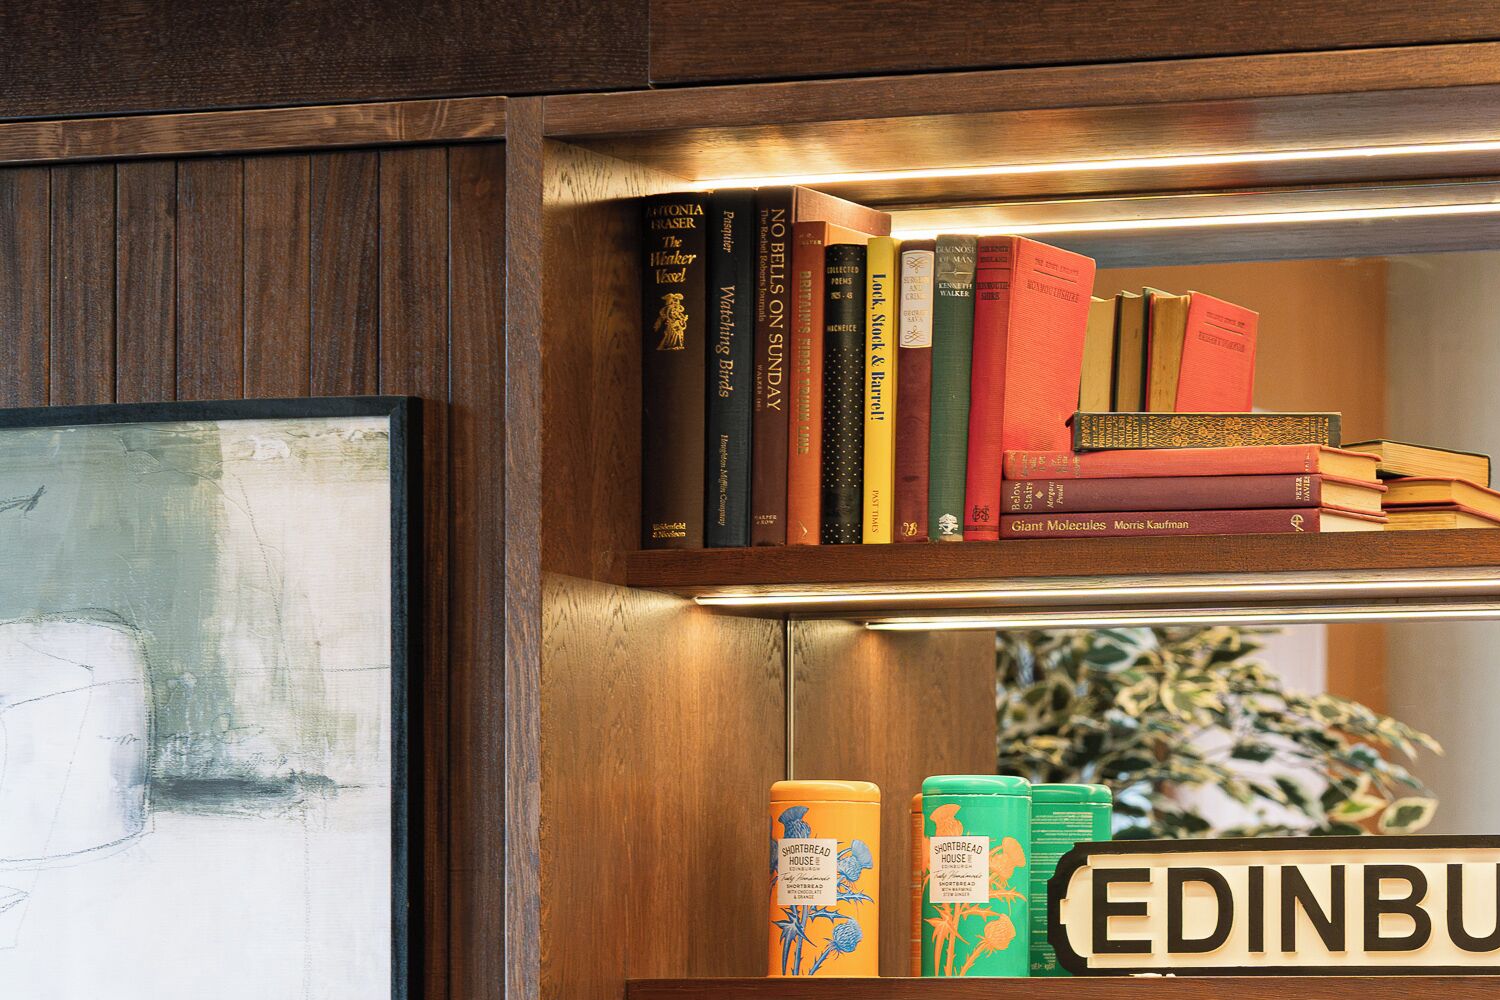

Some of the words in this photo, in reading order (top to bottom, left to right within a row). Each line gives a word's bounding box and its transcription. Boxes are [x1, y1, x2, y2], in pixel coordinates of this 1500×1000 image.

[651, 217, 697, 229] FRASER
[720, 210, 735, 253] Pasquier
[770, 208, 786, 237] NO
[661, 235, 682, 248] The
[760, 226, 768, 253] Rachel
[759, 255, 768, 286] Roberts
[769, 242, 785, 294] BELLS
[953, 256, 974, 264] MAN
[831, 277, 853, 286] POEMS
[870, 274, 887, 310] Lock,
[938, 282, 973, 290] KENNETH
[758, 287, 767, 322] Journals
[768, 299, 784, 328] ON
[715, 285, 736, 355] Watching
[870, 314, 887, 351] Stock
[766, 333, 784, 411] SUNDAY
[870, 355, 886, 367] &
[718, 359, 734, 398] Birds
[869, 371, 886, 421] Barrel!
[871, 490, 881, 507] PAST
[1011, 481, 1021, 510] Below
[1023, 482, 1034, 510] Stairs
[1047, 481, 1056, 508] Margaret
[1295, 477, 1303, 501] PETER
[871, 511, 880, 533] TIMES
[1011, 520, 1044, 532] Giant
[1047, 519, 1107, 531] Molecules
[1114, 519, 1145, 530] Morris
[1146, 519, 1190, 530] Kaufman
[781, 843, 831, 857] SHORTBREAD
[789, 856, 814, 866] HOUSE
[934, 841, 983, 855] SHORTBREAD
[941, 853, 966, 864] HOUSE
